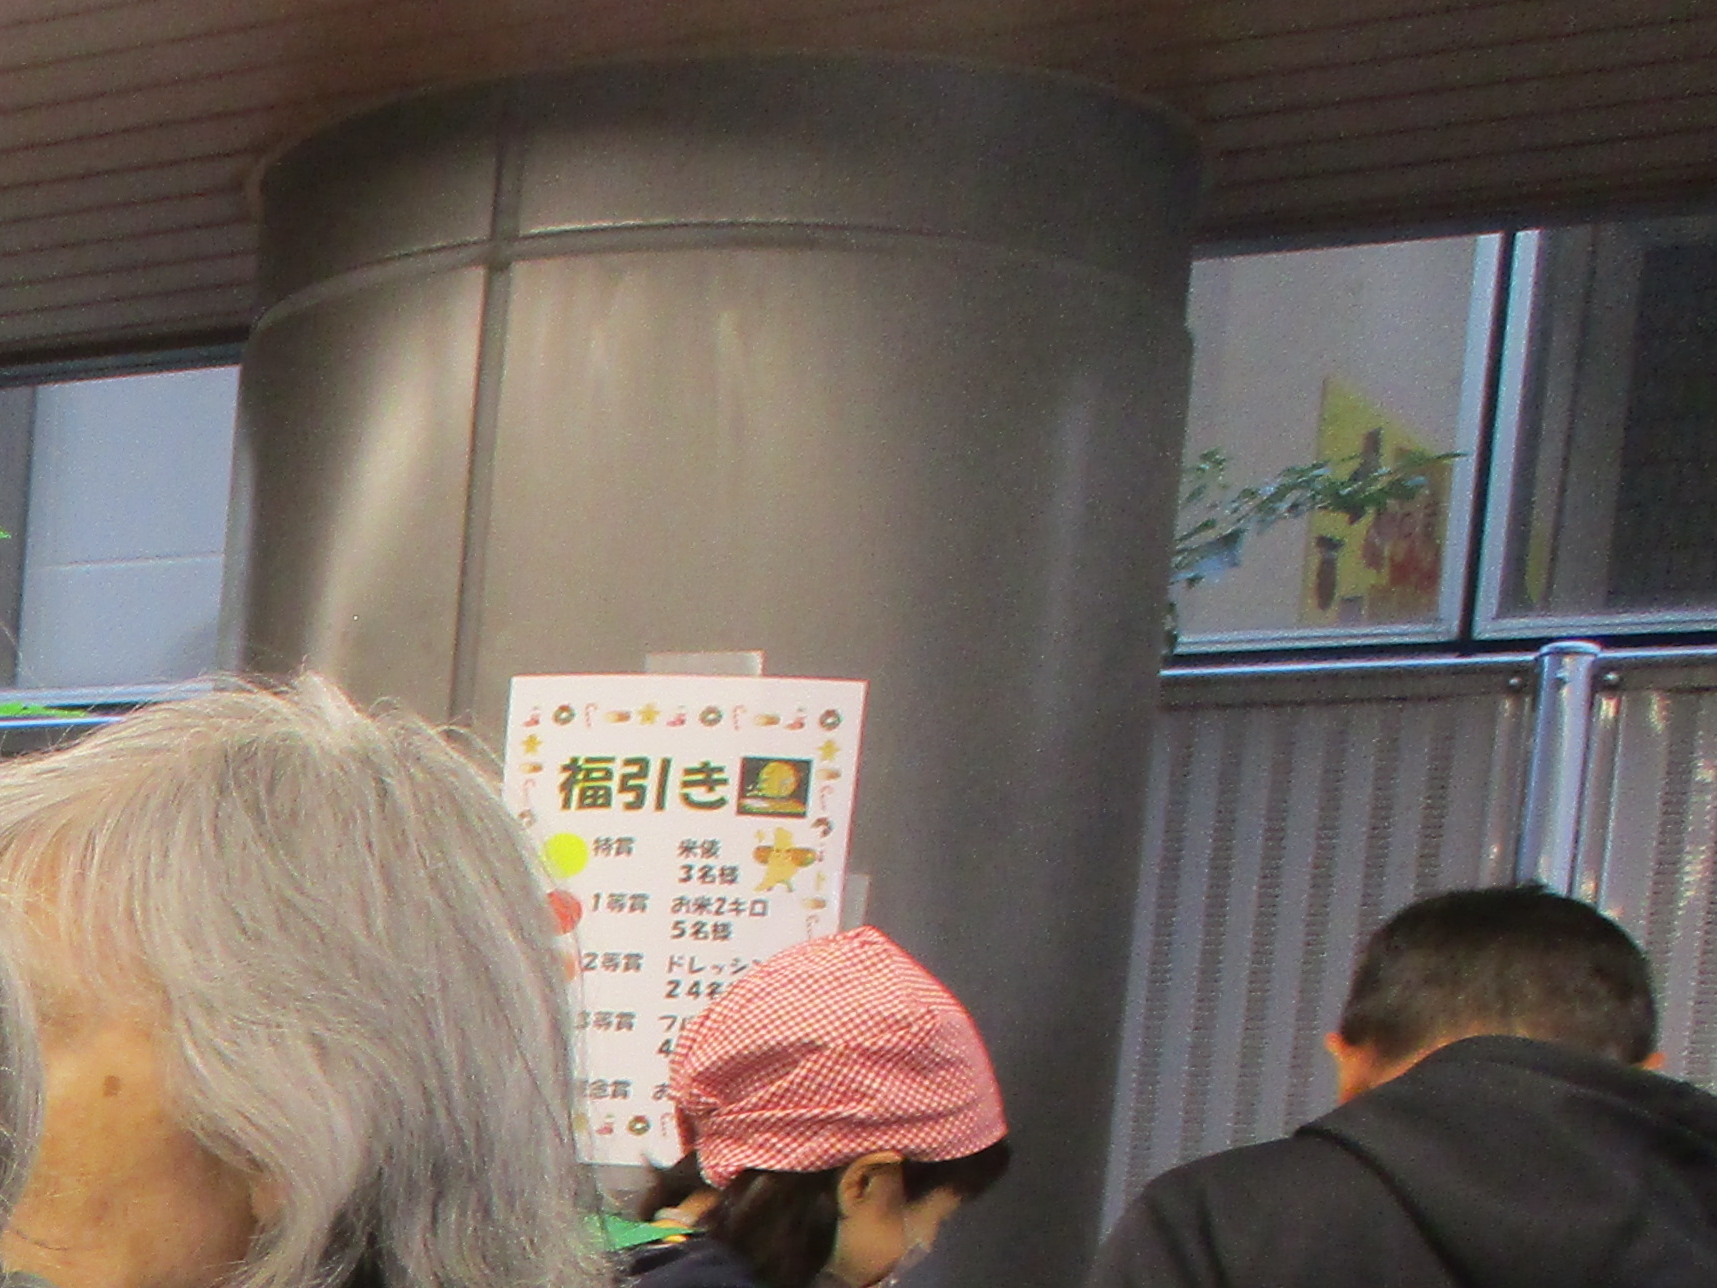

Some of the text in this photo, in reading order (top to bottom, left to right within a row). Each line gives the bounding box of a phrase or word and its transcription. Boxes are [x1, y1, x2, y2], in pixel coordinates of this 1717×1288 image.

[559, 756, 729, 811] 福引き
[677, 864, 739, 885] 3名様
[592, 892, 769, 917] 1等賞 お米2キロ
[670, 919, 733, 942] 5名様
